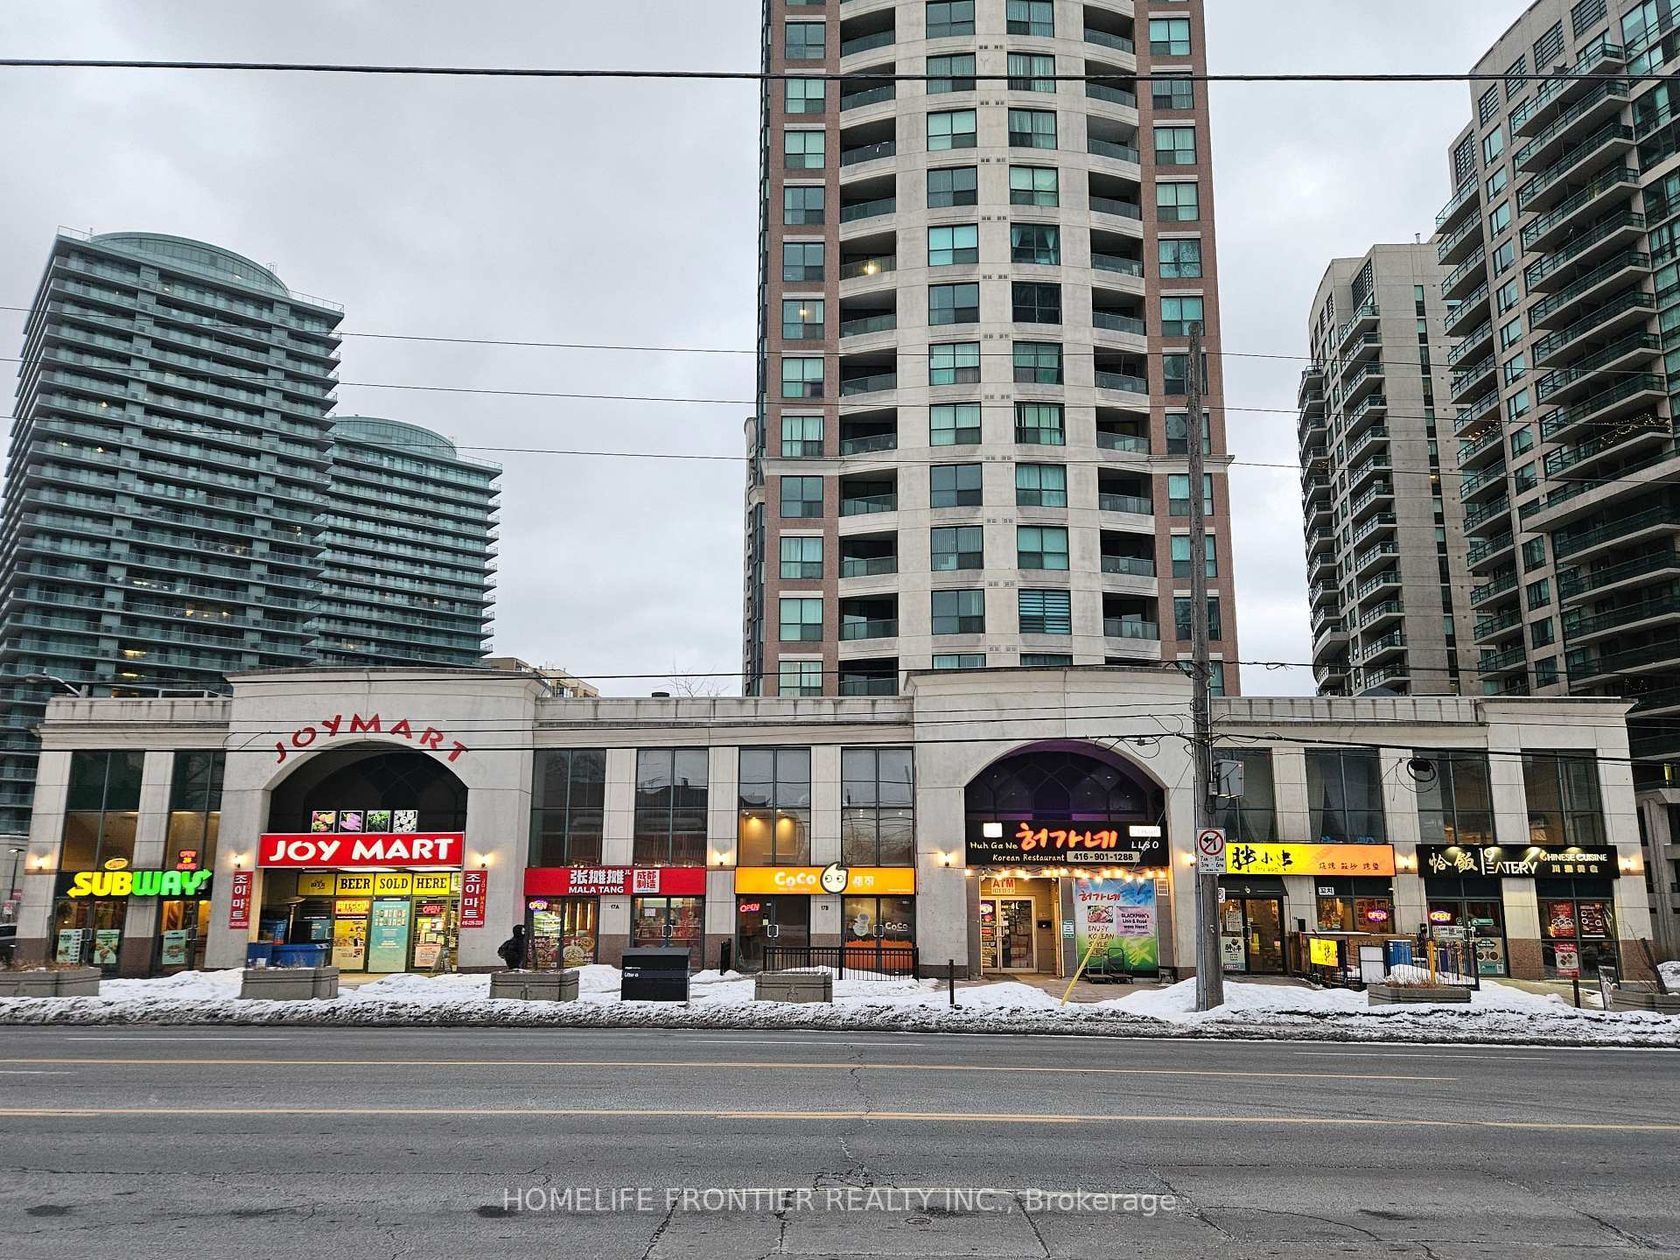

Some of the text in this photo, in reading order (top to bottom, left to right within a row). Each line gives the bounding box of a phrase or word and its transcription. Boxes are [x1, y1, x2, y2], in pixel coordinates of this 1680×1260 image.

[1016, 822, 1118, 851] 허가네
[269, 838, 453, 861] JOY MART
[1006, 842, 1019, 850] Ne
[992, 853, 1134, 862] Korean Restaurant 416-901-1288
[1540, 851, 1608, 861] CHINESE CUISINE
[1486, 861, 1538, 874] EATERY
[67, 869, 212, 898] SUBWAY
[340, 878, 371, 889] BEER
[379, 878, 409, 889] SOLD
[416, 878, 447, 889] HERE
[774, 872, 816, 886] CoCo
[993, 879, 1014, 888] ATM
[232, 874, 248, 920] 조이마트
[463, 873, 481, 919] 조이마트
[422, 905, 441, 914] OPEN
[740, 903, 760, 912] OPEN
[1368, 912, 1387, 920] OPEN
[885, 922, 909, 931] CoCo
